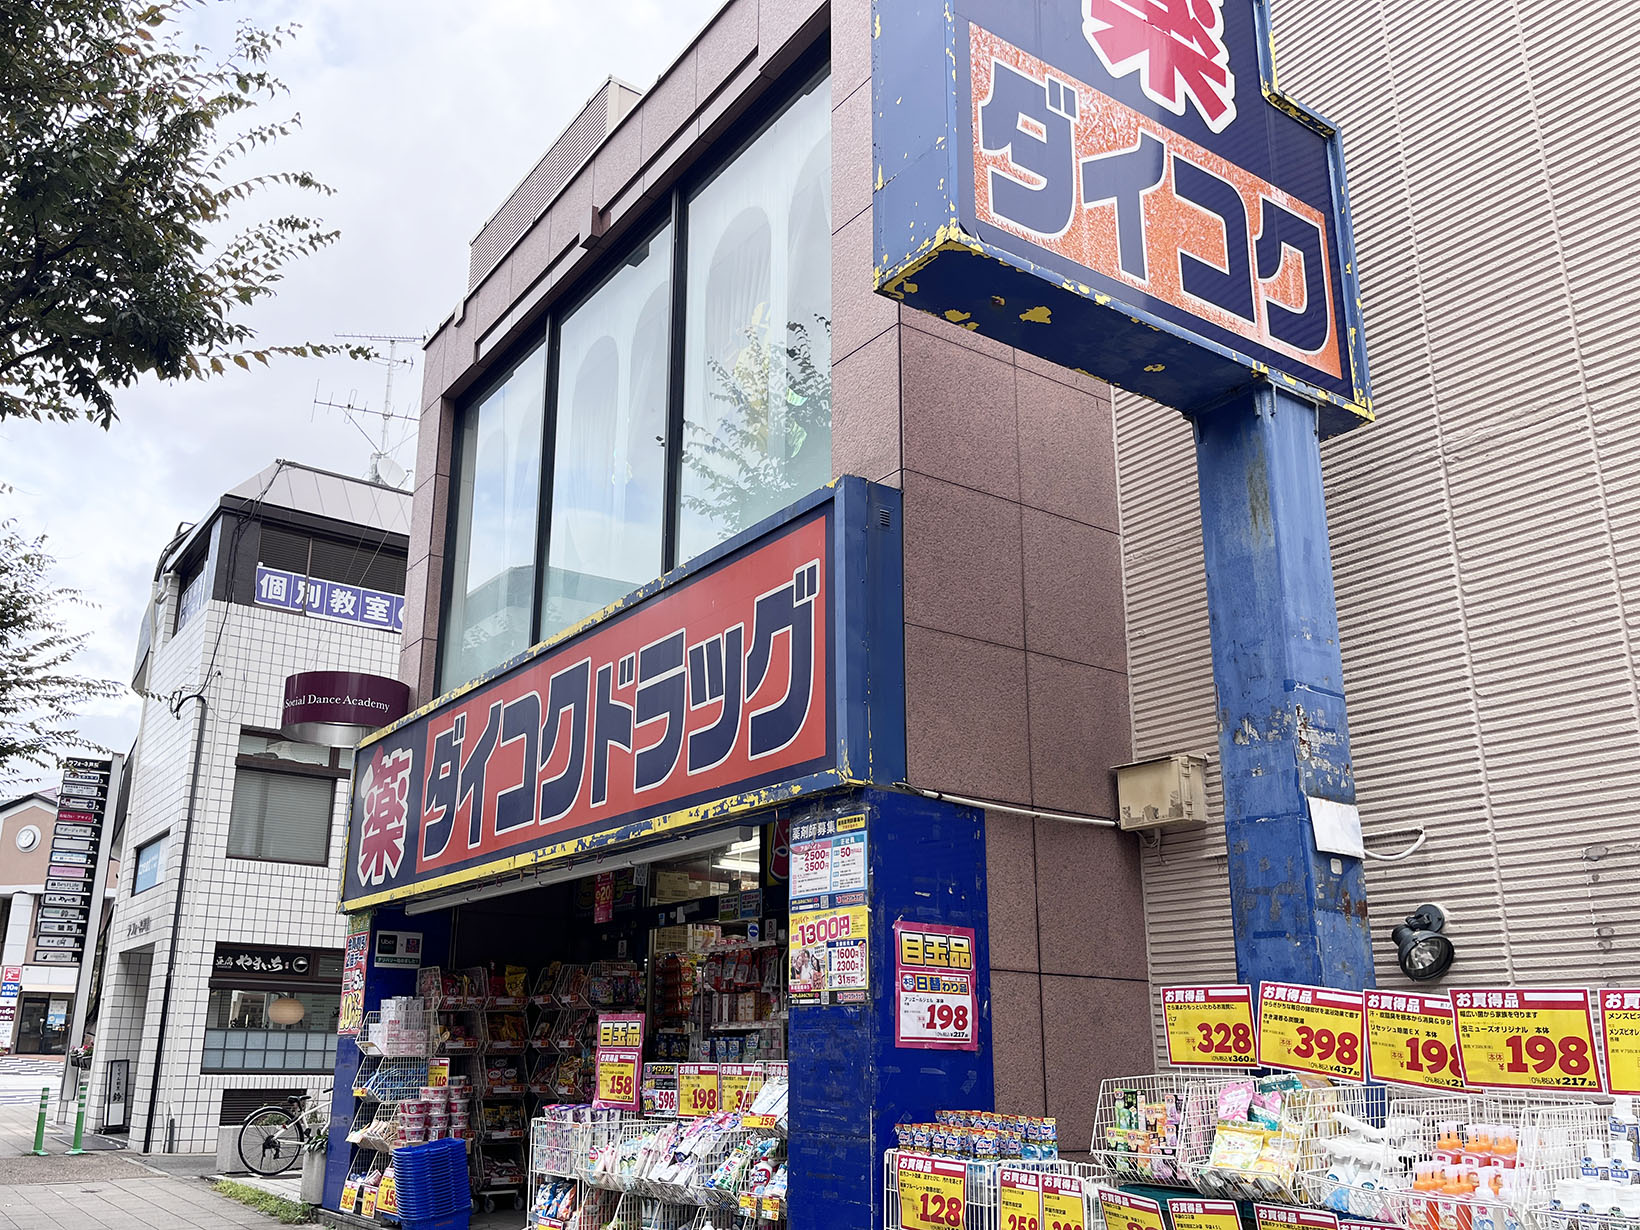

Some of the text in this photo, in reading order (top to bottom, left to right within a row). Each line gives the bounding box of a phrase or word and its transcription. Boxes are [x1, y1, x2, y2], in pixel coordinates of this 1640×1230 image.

[977, 56, 1329, 355] ダイコク
[259, 573, 405, 623] 個別教室
[284, 694, 390, 713] Social Dance Academy
[422, 558, 821, 863] ダイコクドラッグ
[357, 745, 413, 886] 薬
[792, 821, 836, 841] 薬剤師募集
[798, 915, 850, 947] 1300円
[900, 931, 972, 970] 目玉品
[1165, 989, 1205, 1002] お買得品
[1262, 985, 1312, 1004] お買得品
[1367, 994, 1420, 1013] お買得品
[1456, 992, 1519, 1009] お買得品
[926, 1004, 969, 1031] 198
[600, 1021, 641, 1048] 目玉品
[1196, 1022, 1252, 1054] 328
[1534, 1026, 1550, 1034] 本体
[1292, 1025, 1359, 1066] 398
[1505, 1035, 1591, 1076] 198
[608, 1075, 633, 1095] 158
[658, 1090, 675, 1110] 598
[691, 1088, 717, 1110] 198
[760, 1117, 776, 1127] 158
[899, 1157, 932, 1173] お買得品
[1002, 1171, 1037, 1186] お買得品
[1044, 1176, 1080, 1192] お買得品
[1101, 1192, 1130, 1207] お買得品
[1172, 1202, 1204, 1214] お買得品
[919, 1192, 962, 1228] 128
[1258, 1208, 1298, 1224] お買得品
